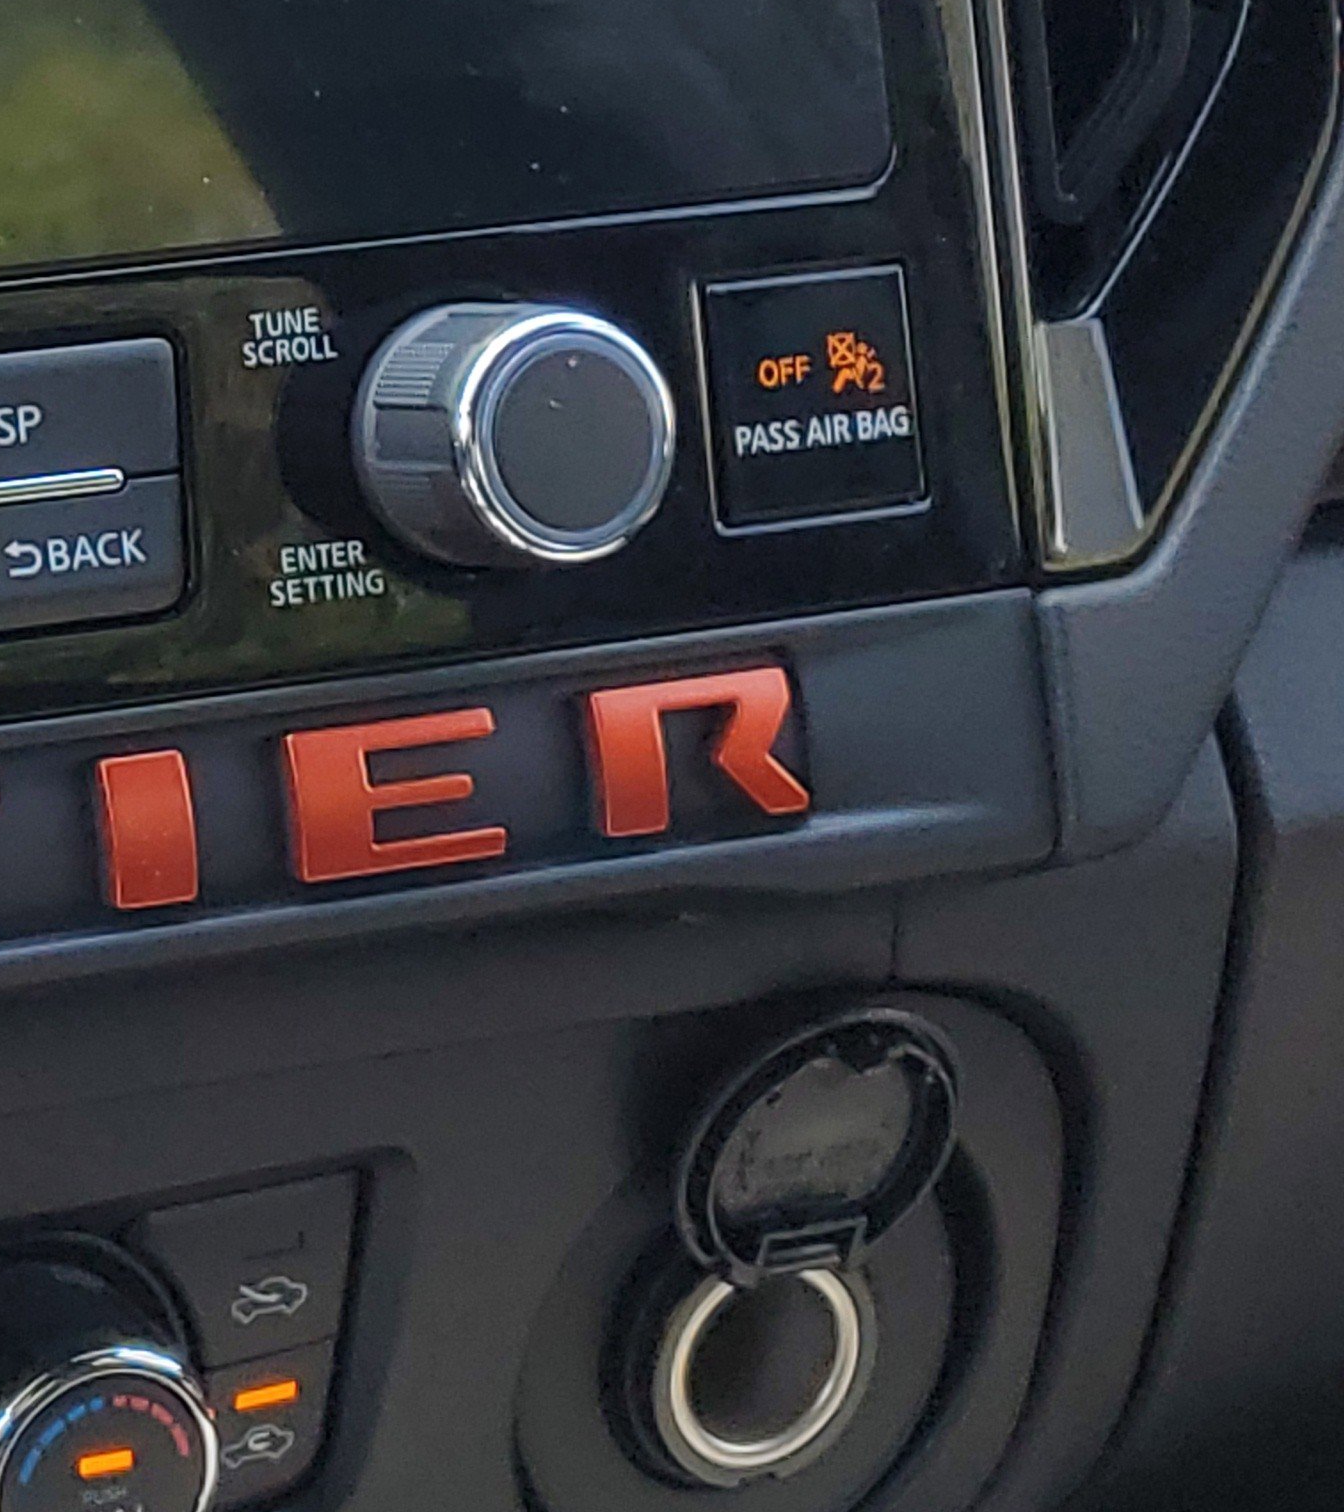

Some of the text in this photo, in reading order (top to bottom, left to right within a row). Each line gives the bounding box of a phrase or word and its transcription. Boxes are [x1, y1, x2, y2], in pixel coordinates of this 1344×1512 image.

[248, 306, 321, 341] TUNE
[242, 331, 339, 369] SCROLL
[757, 355, 812, 388] OFF
[734, 405, 911, 456] PASS AIR BAG
[46, 528, 147, 574] BACK
[280, 540, 366, 574] ENTER
[268, 569, 385, 608] SETTING
